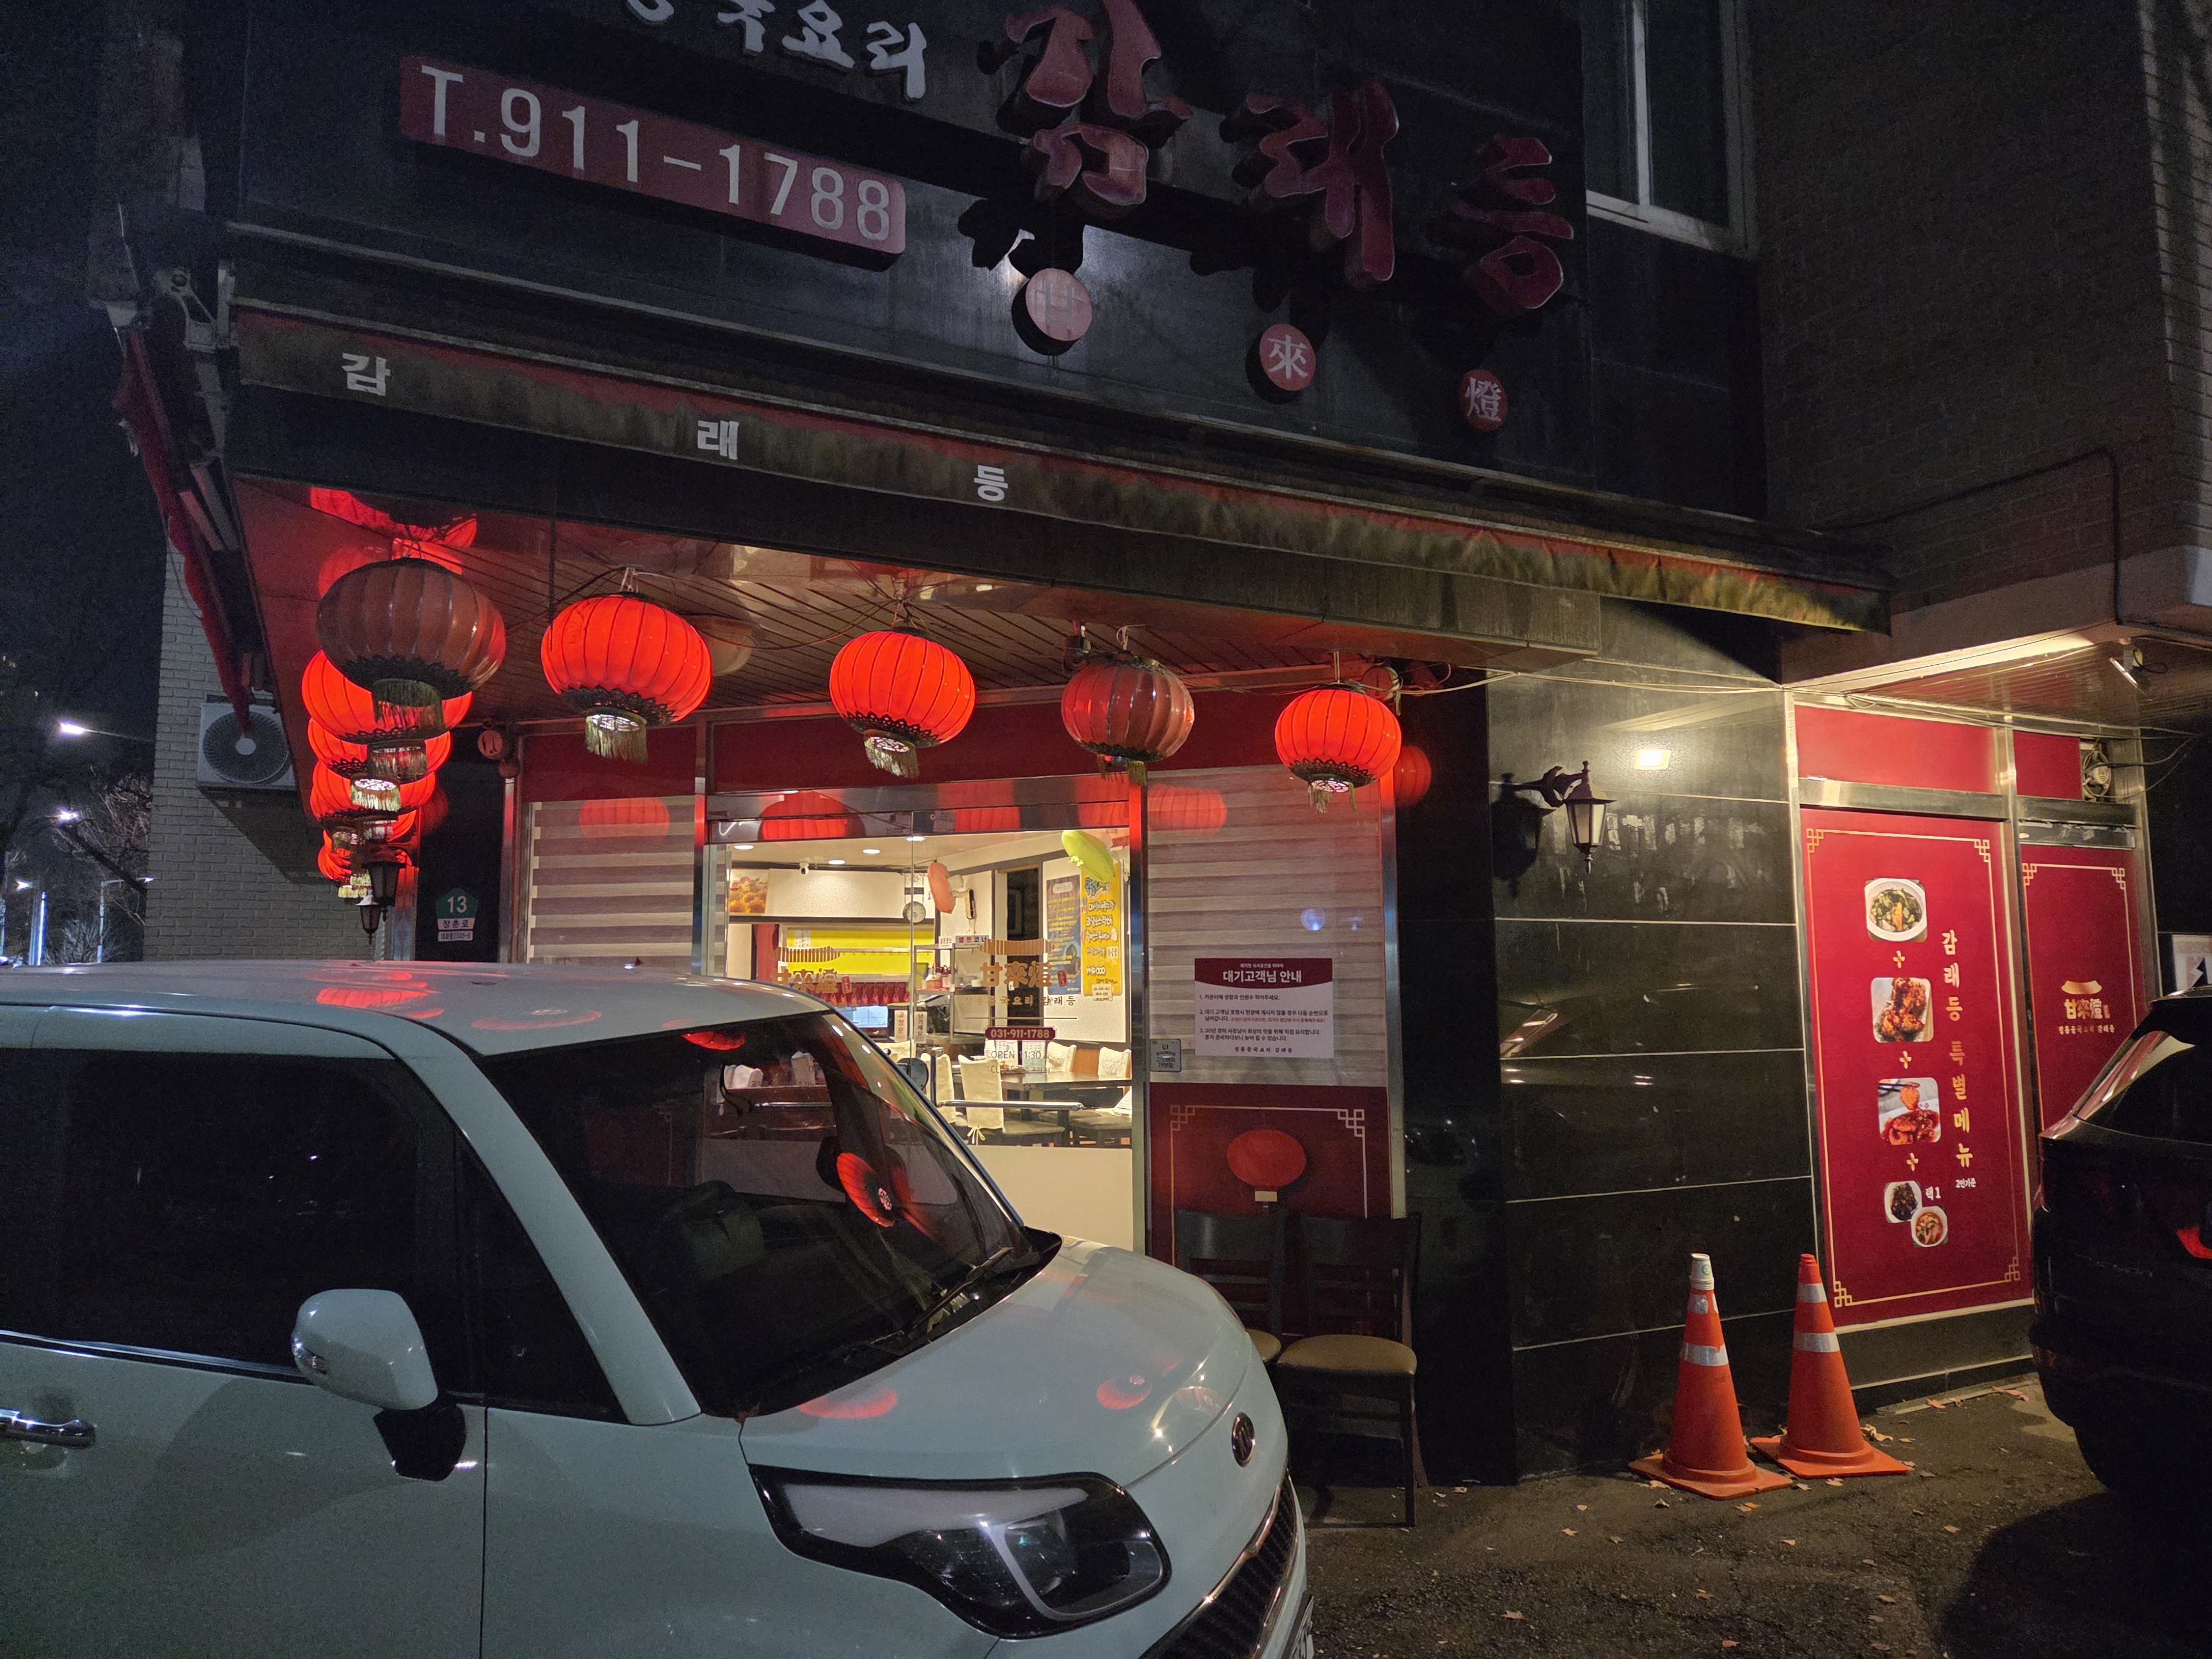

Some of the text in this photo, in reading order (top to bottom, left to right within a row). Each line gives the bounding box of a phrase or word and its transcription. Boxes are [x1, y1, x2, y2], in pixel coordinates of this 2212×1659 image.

[420, 65, 891, 242] T.911-1788
[447, 895, 468, 913] 13
[443, 919, 469, 928] 장촌로
[1223, 970, 1302, 983] 대기고객님 안내
[1042, 995, 1076, 1006] 감래등
[990, 1029, 1050, 1039] 031-911-1788
[1941, 929, 1974, 1168] 감래등 특별메뉴
[991, 1050, 1015, 1059] OPEN
[1019, 1050, 1041, 1060] 11:30
[1955, 1177, 1976, 1188] 2인기준
[1925, 1186, 1942, 1201] 택1
